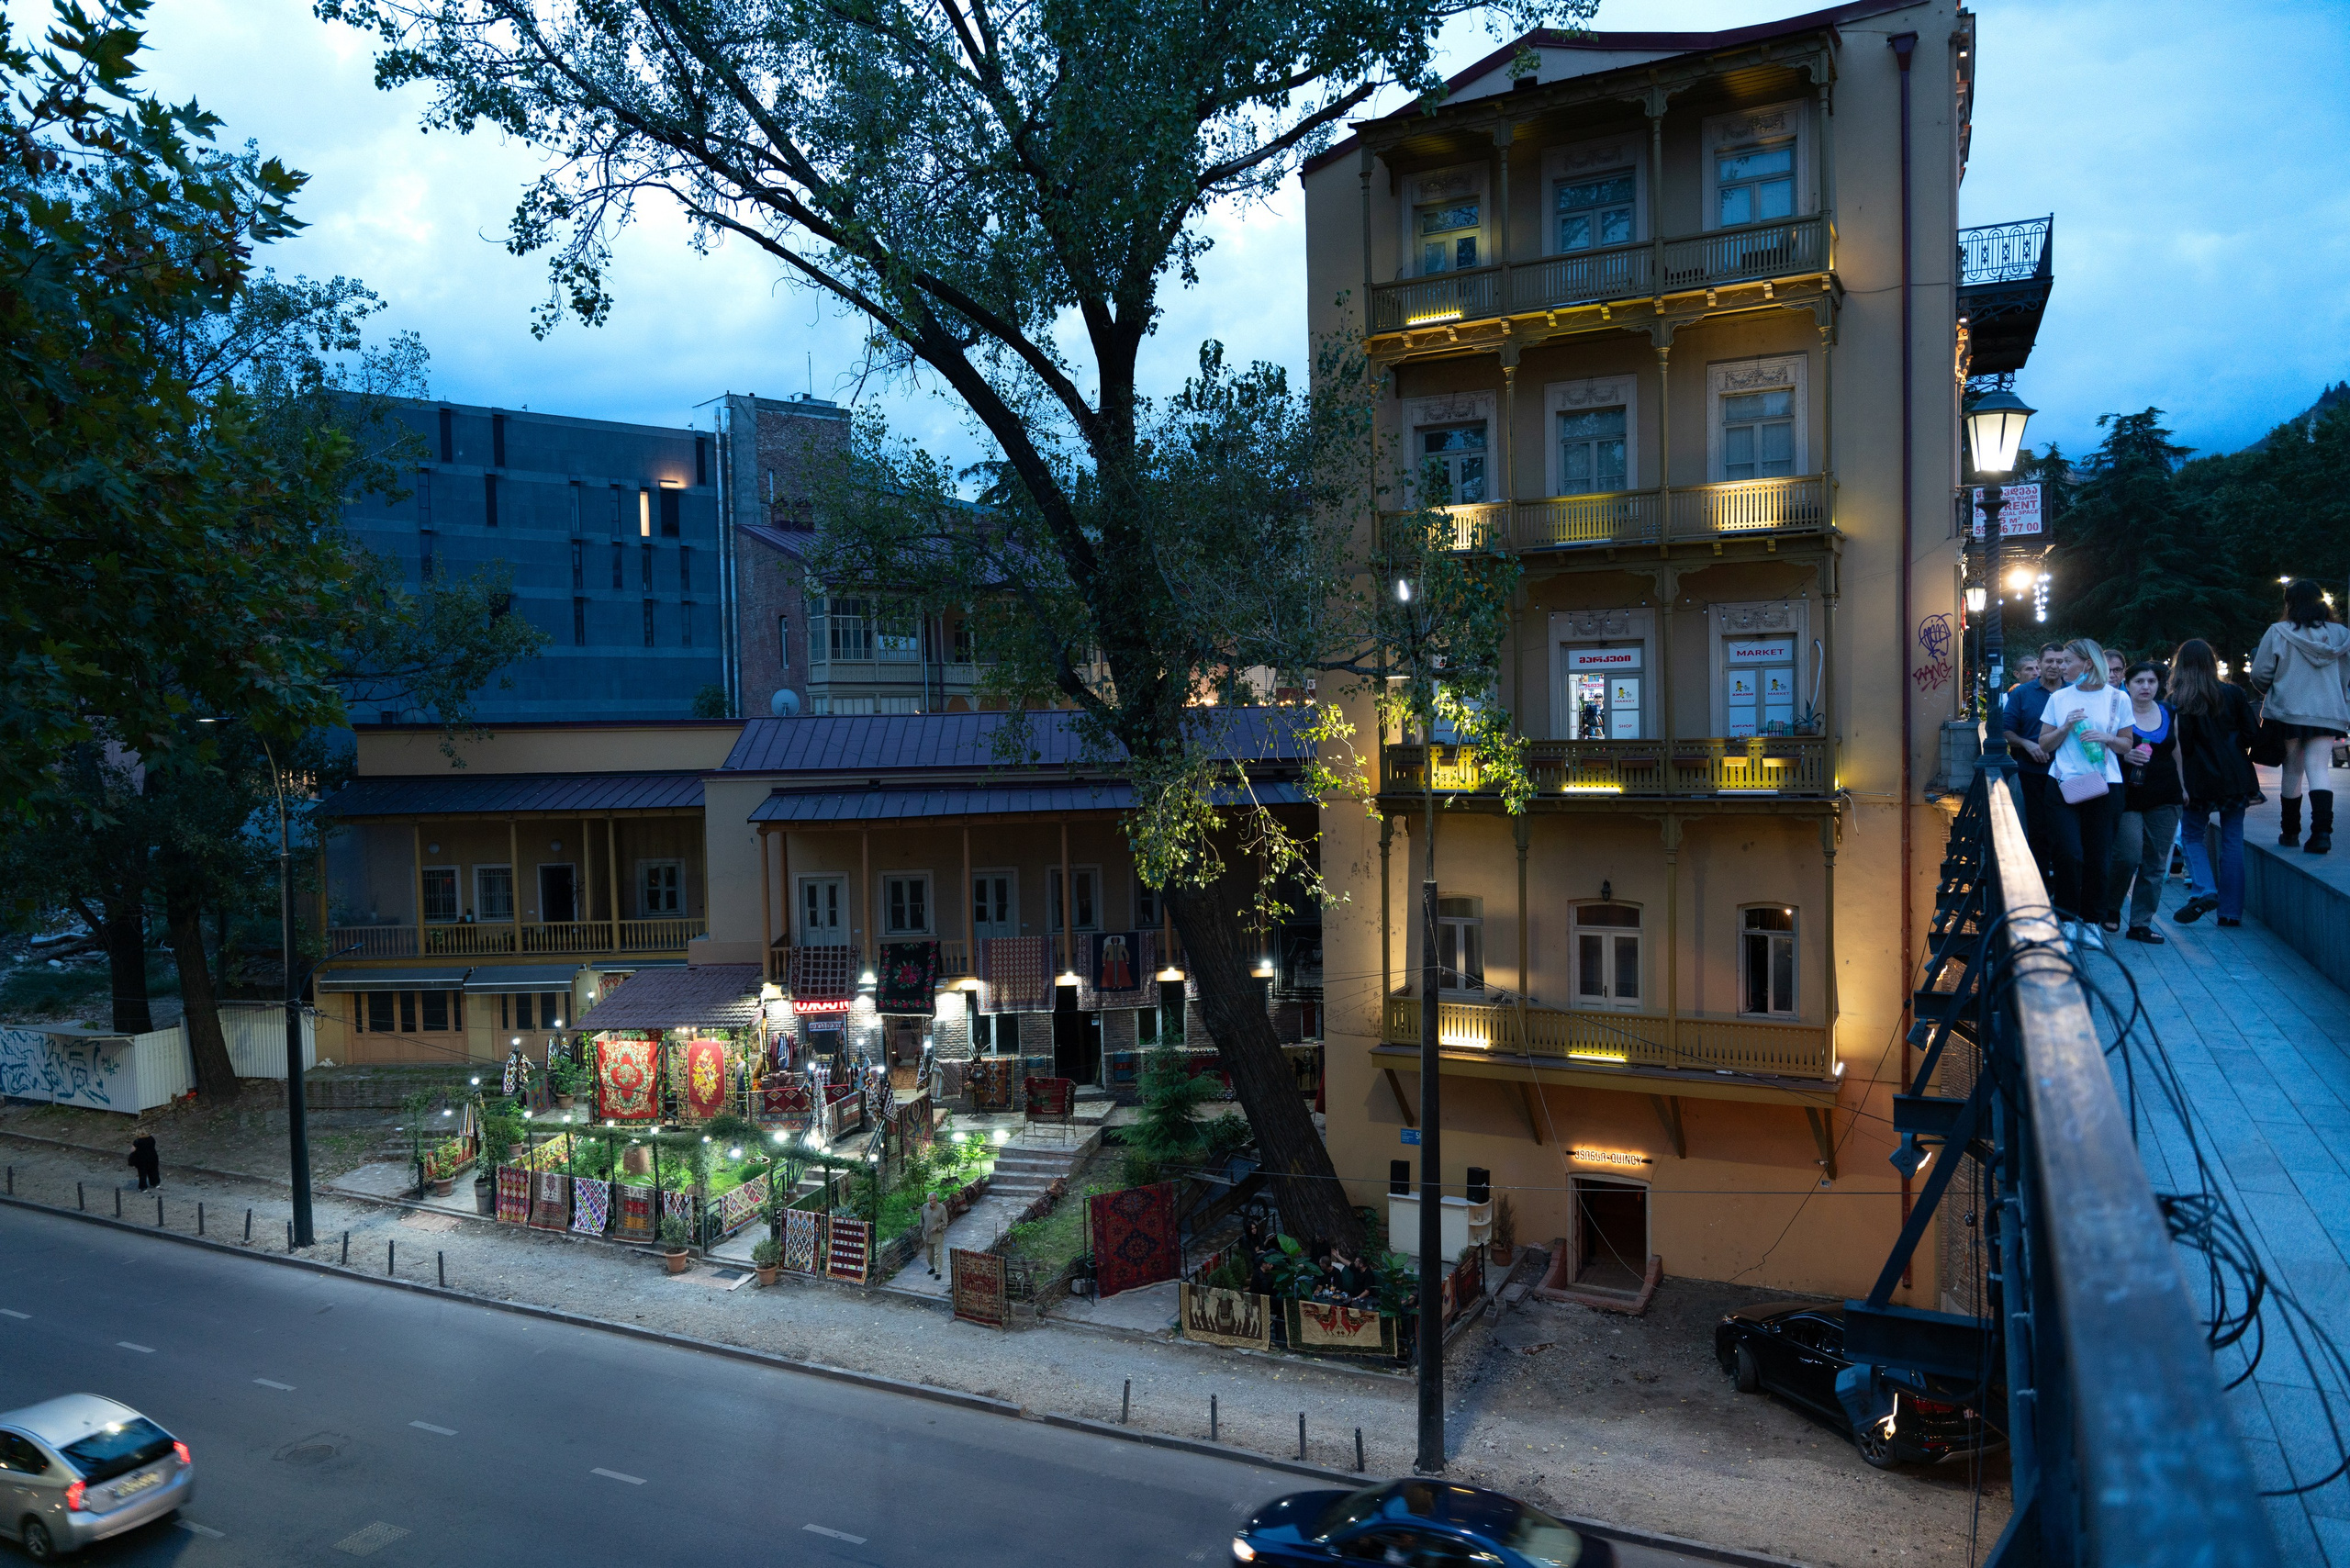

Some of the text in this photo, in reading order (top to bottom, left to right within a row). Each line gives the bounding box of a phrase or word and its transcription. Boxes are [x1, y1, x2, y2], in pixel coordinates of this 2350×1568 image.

[2004, 500, 2038, 511] RENT
[2011, 523, 2023, 532] 77
[2027, 522, 2039, 532] 00
[1736, 648, 1785, 657] MARKET
[1579, 655, 1631, 664] მარკეტი
